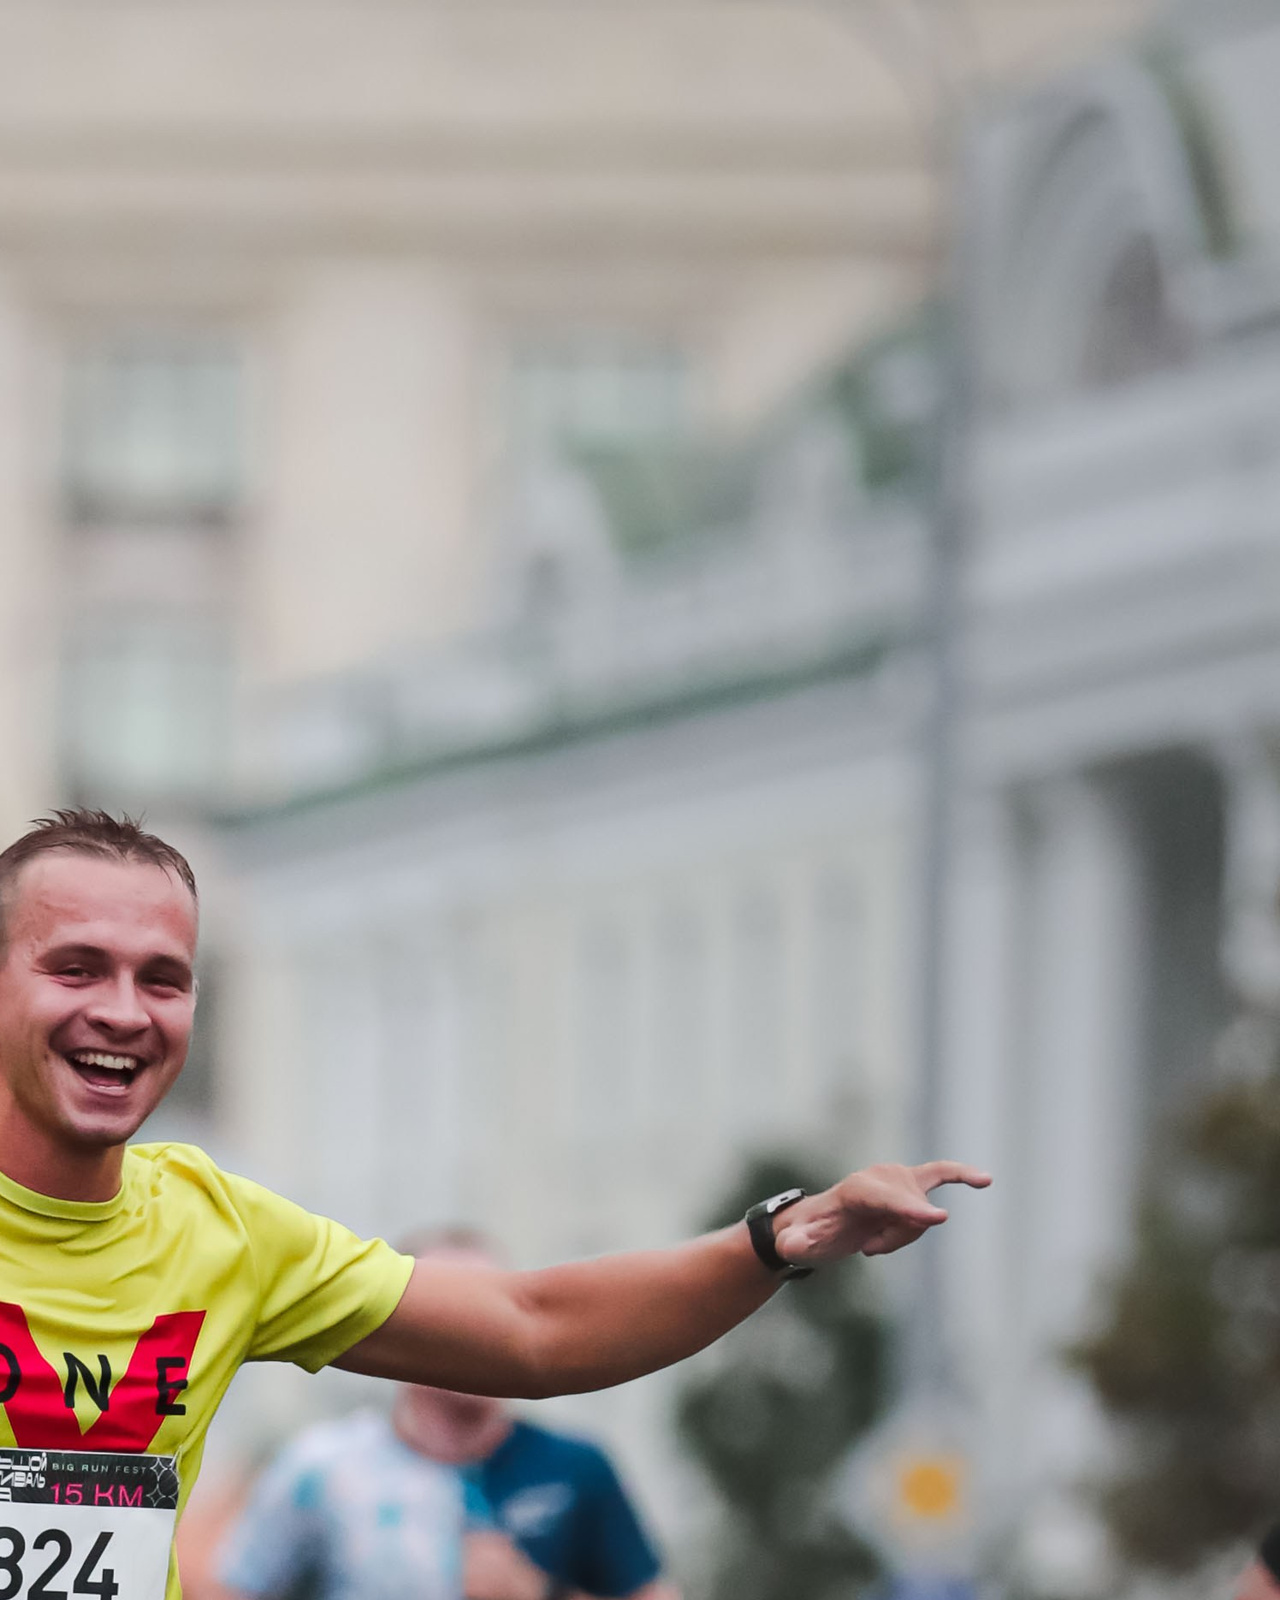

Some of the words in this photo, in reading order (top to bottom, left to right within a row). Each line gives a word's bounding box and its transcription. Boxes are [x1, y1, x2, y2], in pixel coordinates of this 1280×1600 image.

[52, 1462, 74, 1472] BIG
[81, 1464, 109, 1473] RUN
[115, 1465, 147, 1474] FEST
[50, 1482, 83, 1505] 15
